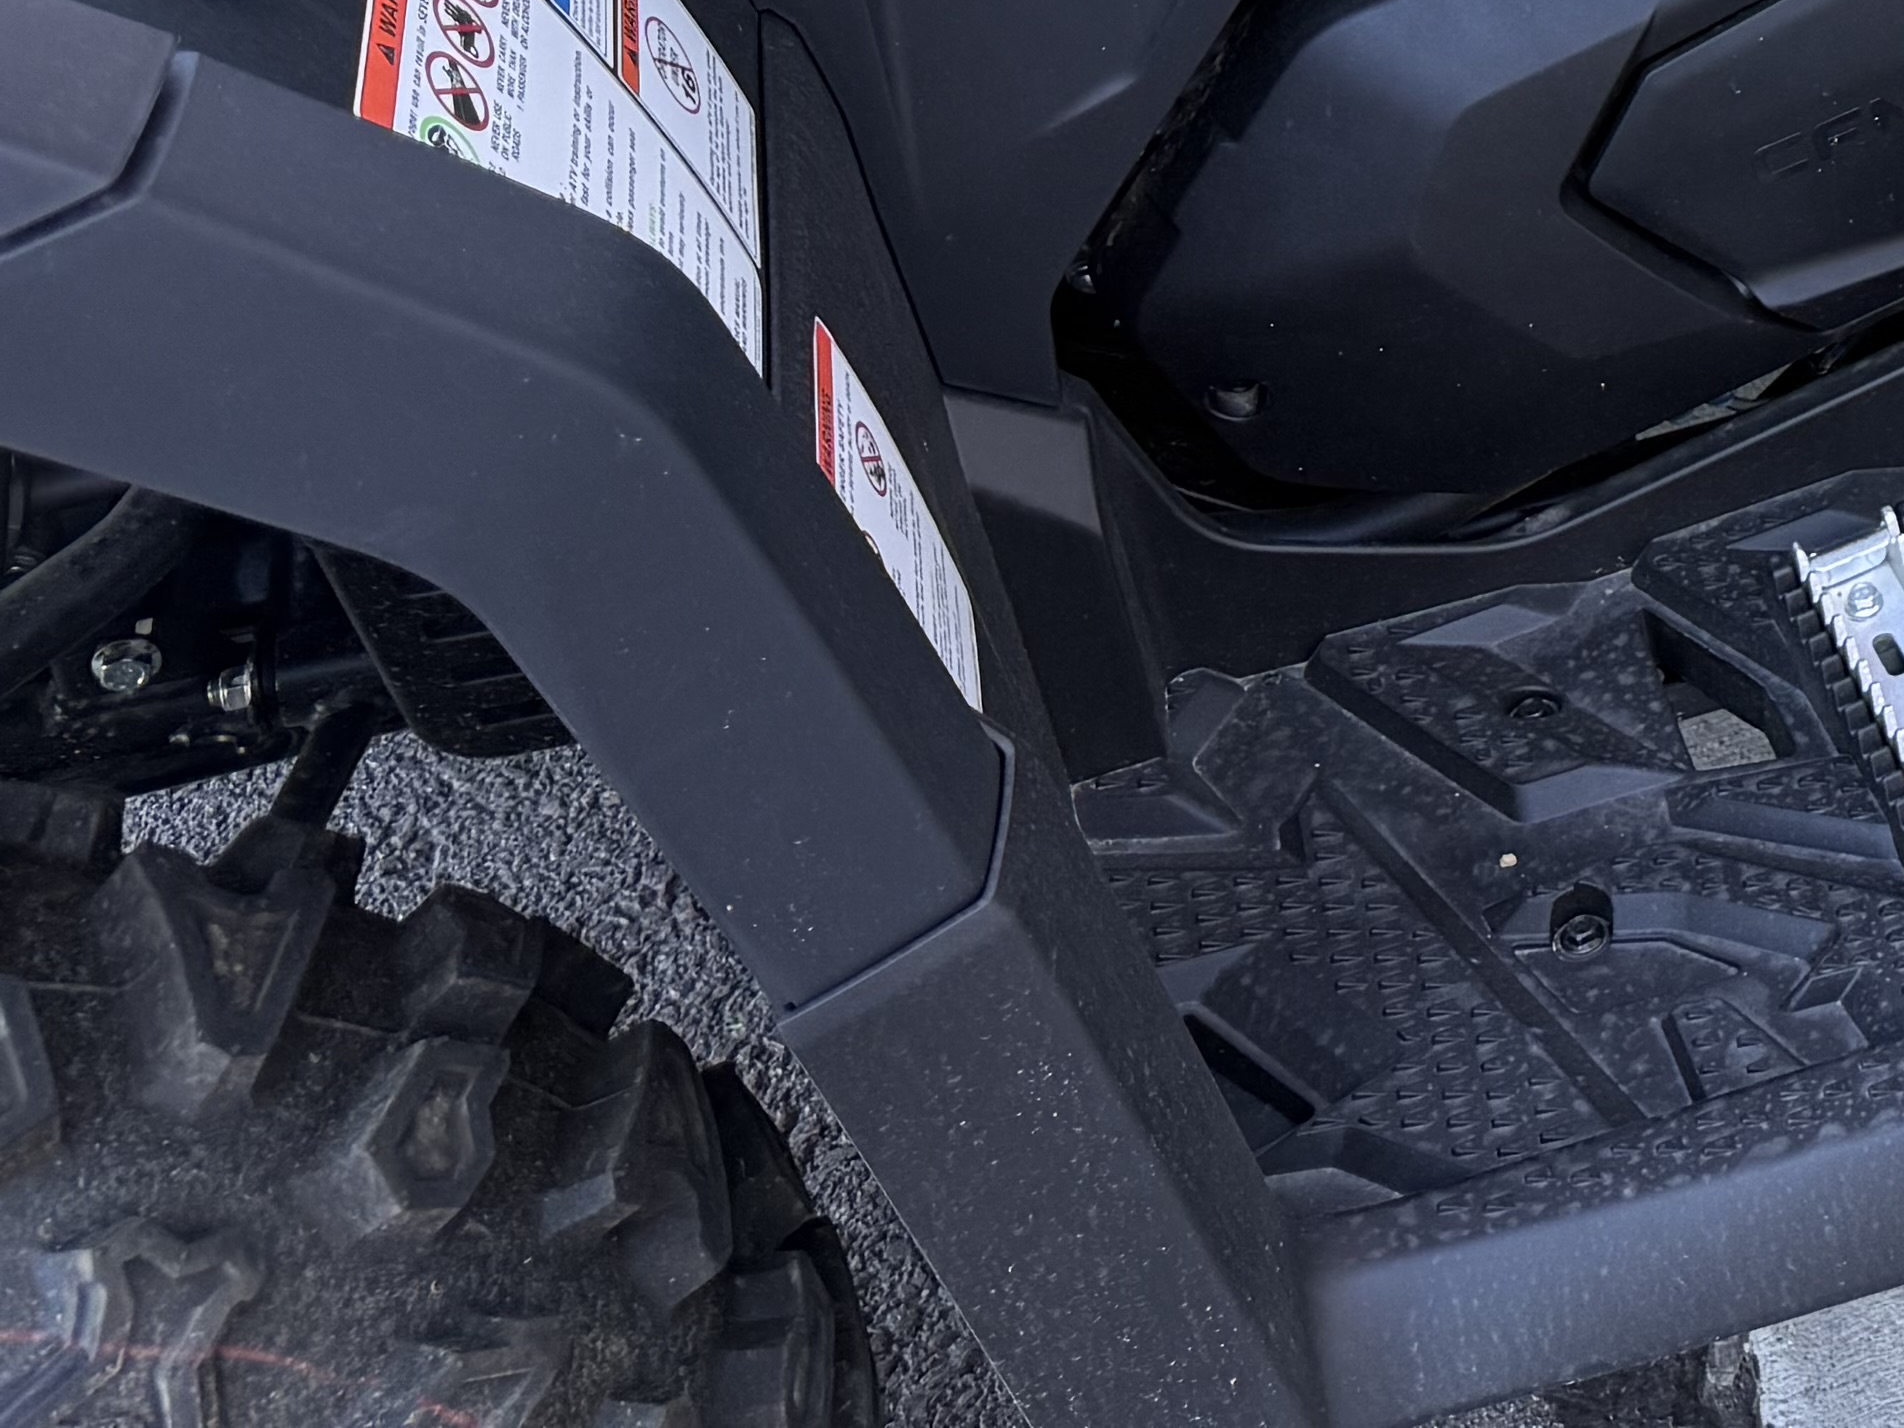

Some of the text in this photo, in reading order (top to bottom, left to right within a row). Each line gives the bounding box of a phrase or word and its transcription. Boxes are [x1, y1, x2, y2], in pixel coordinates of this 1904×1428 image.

[675, 68, 704, 104] 16
[571, 124, 580, 166] training
[568, 165, 576, 191] ATV
[580, 182, 589, 206] fast
[604, 158, 613, 206] collision
